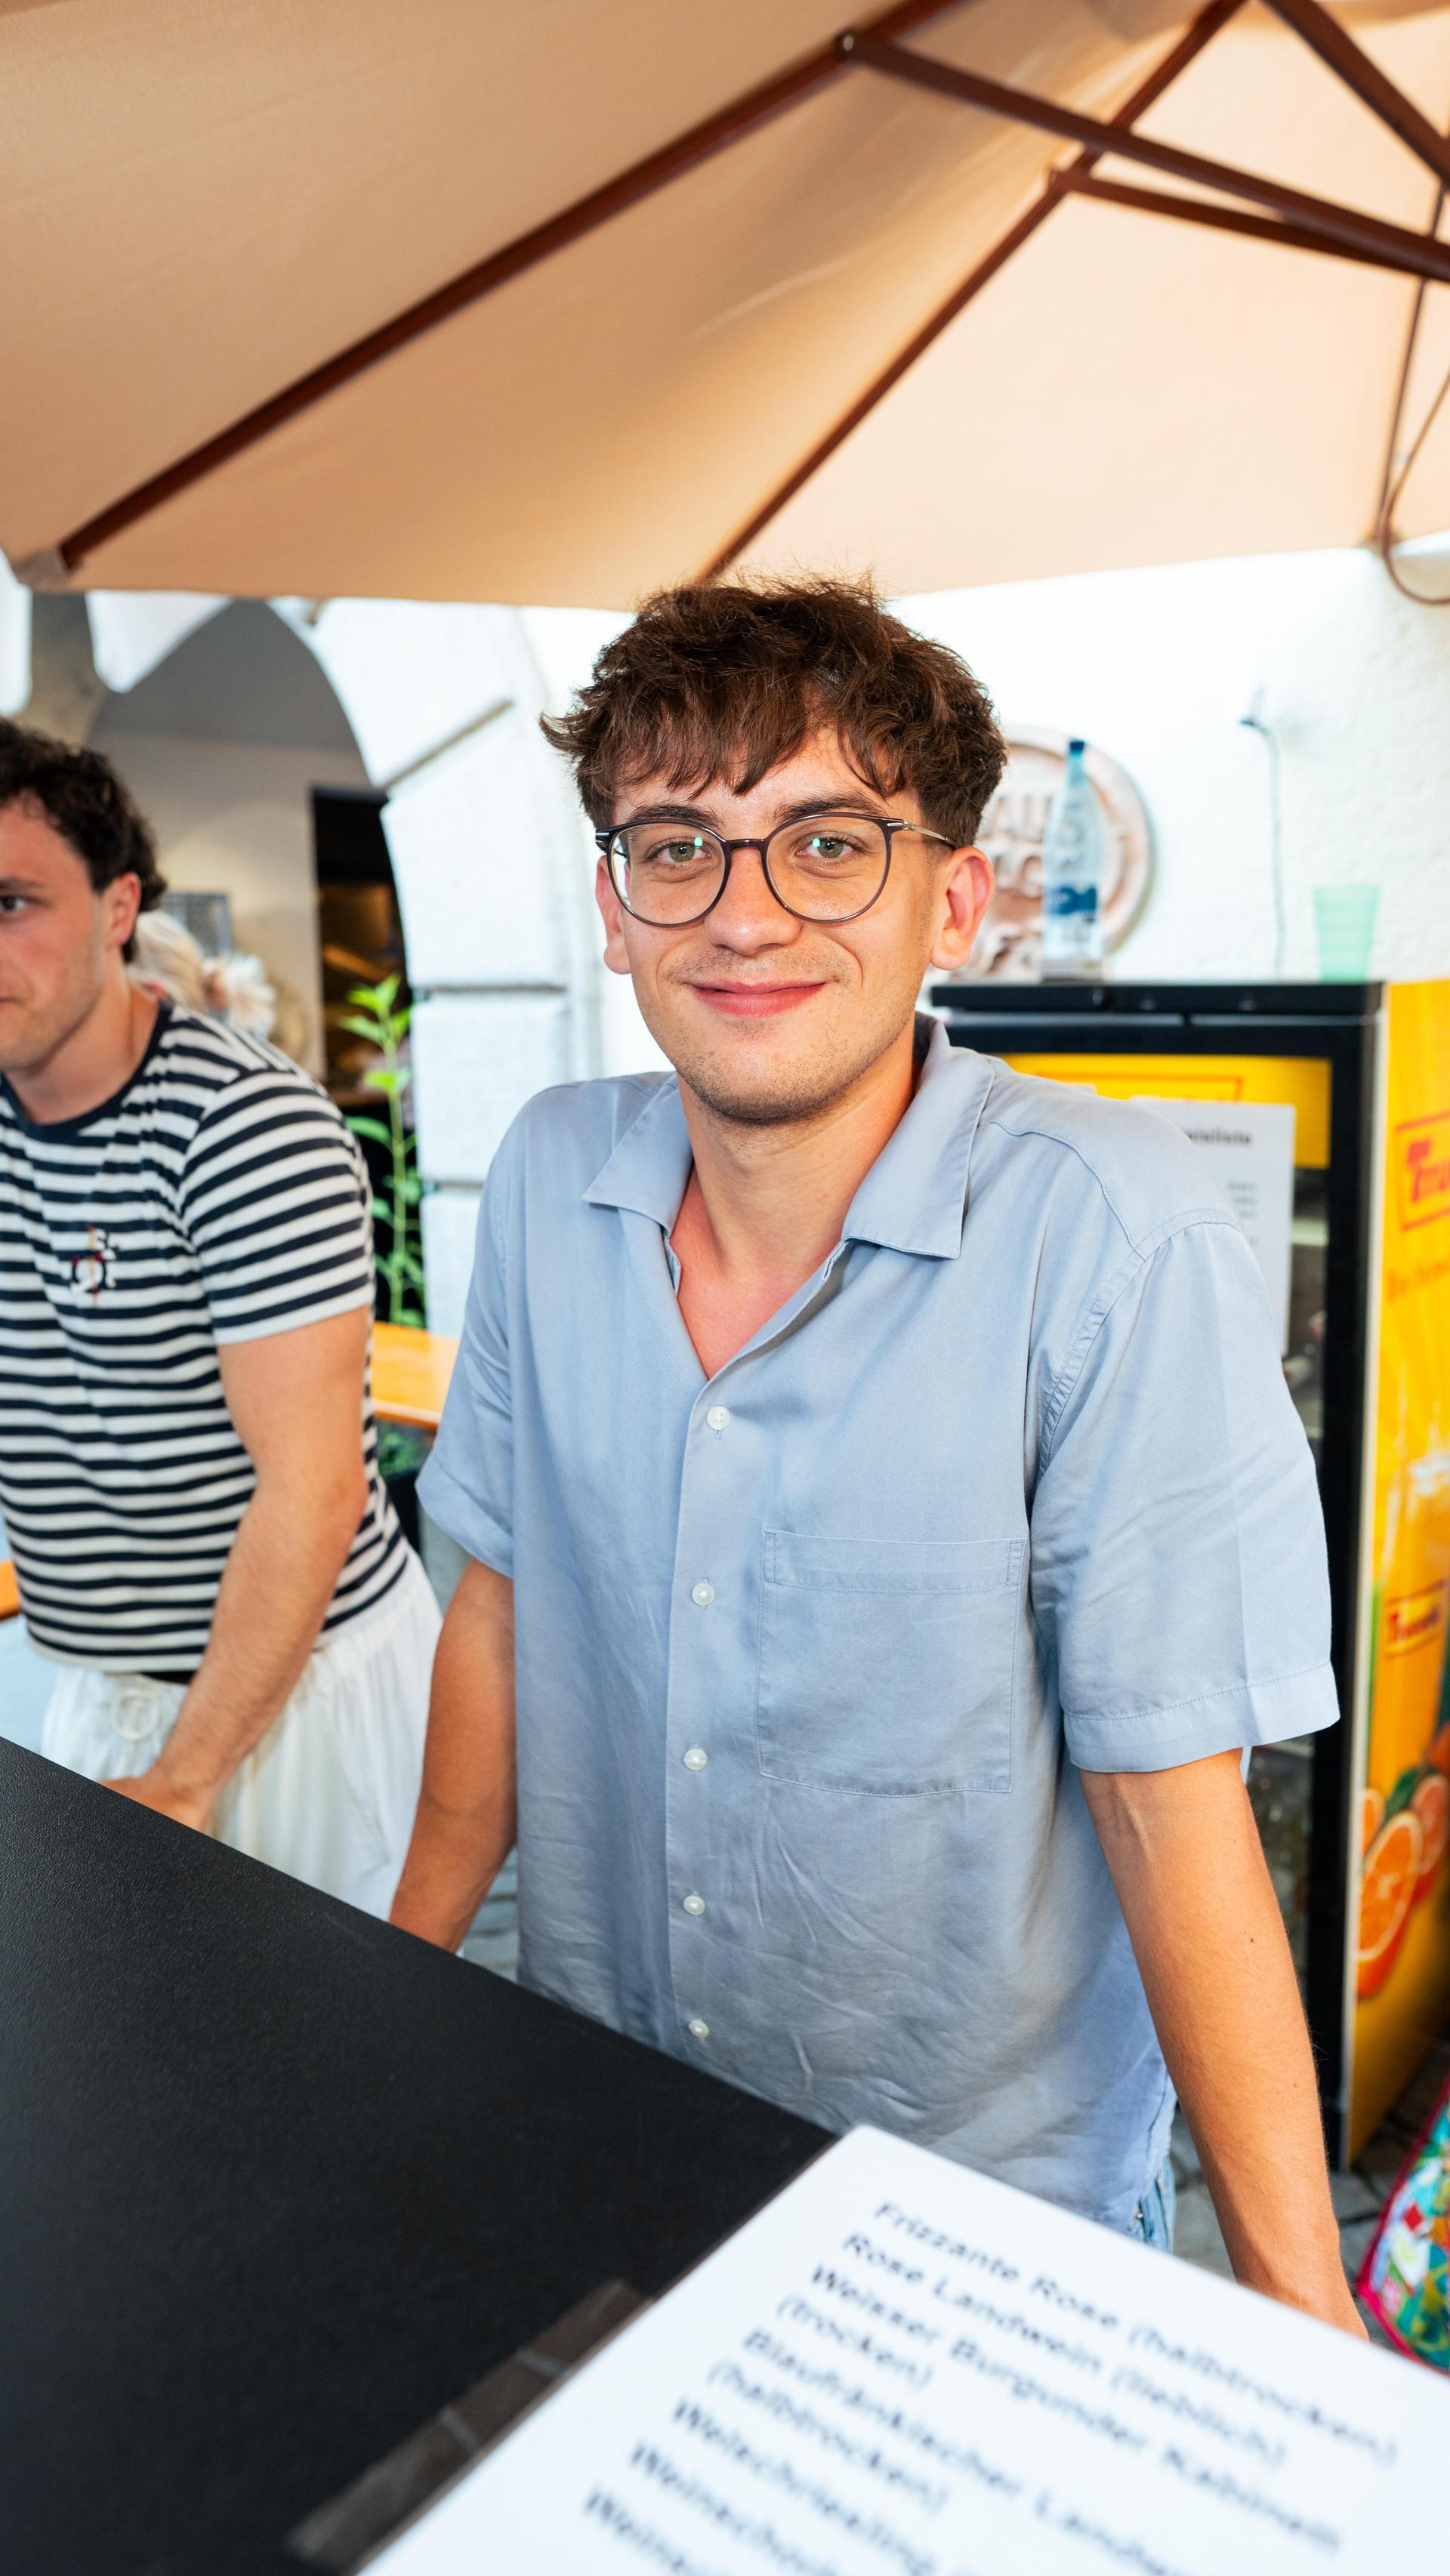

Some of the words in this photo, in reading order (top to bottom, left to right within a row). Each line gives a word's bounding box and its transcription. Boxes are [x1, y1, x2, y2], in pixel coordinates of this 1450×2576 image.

[1183, 1128, 1253, 1145] eisliste
[776, 2294, 934, 2393] (trocken)
[810, 2262, 941, 2343] Weisser
[949, 2337, 1148, 2452] Burgunder
[841, 2231, 926, 2284] Rose
[932, 2276, 1102, 2374] Landwein
[1110, 2368, 1286, 2466] (lieblich)
[874, 2201, 1020, 2281] Frizzante
[1029, 2274, 1119, 2330] Rose
[1128, 2325, 1399, 2467] (halbtrocken)
[707, 2359, 949, 2515] (halbtrocken)
